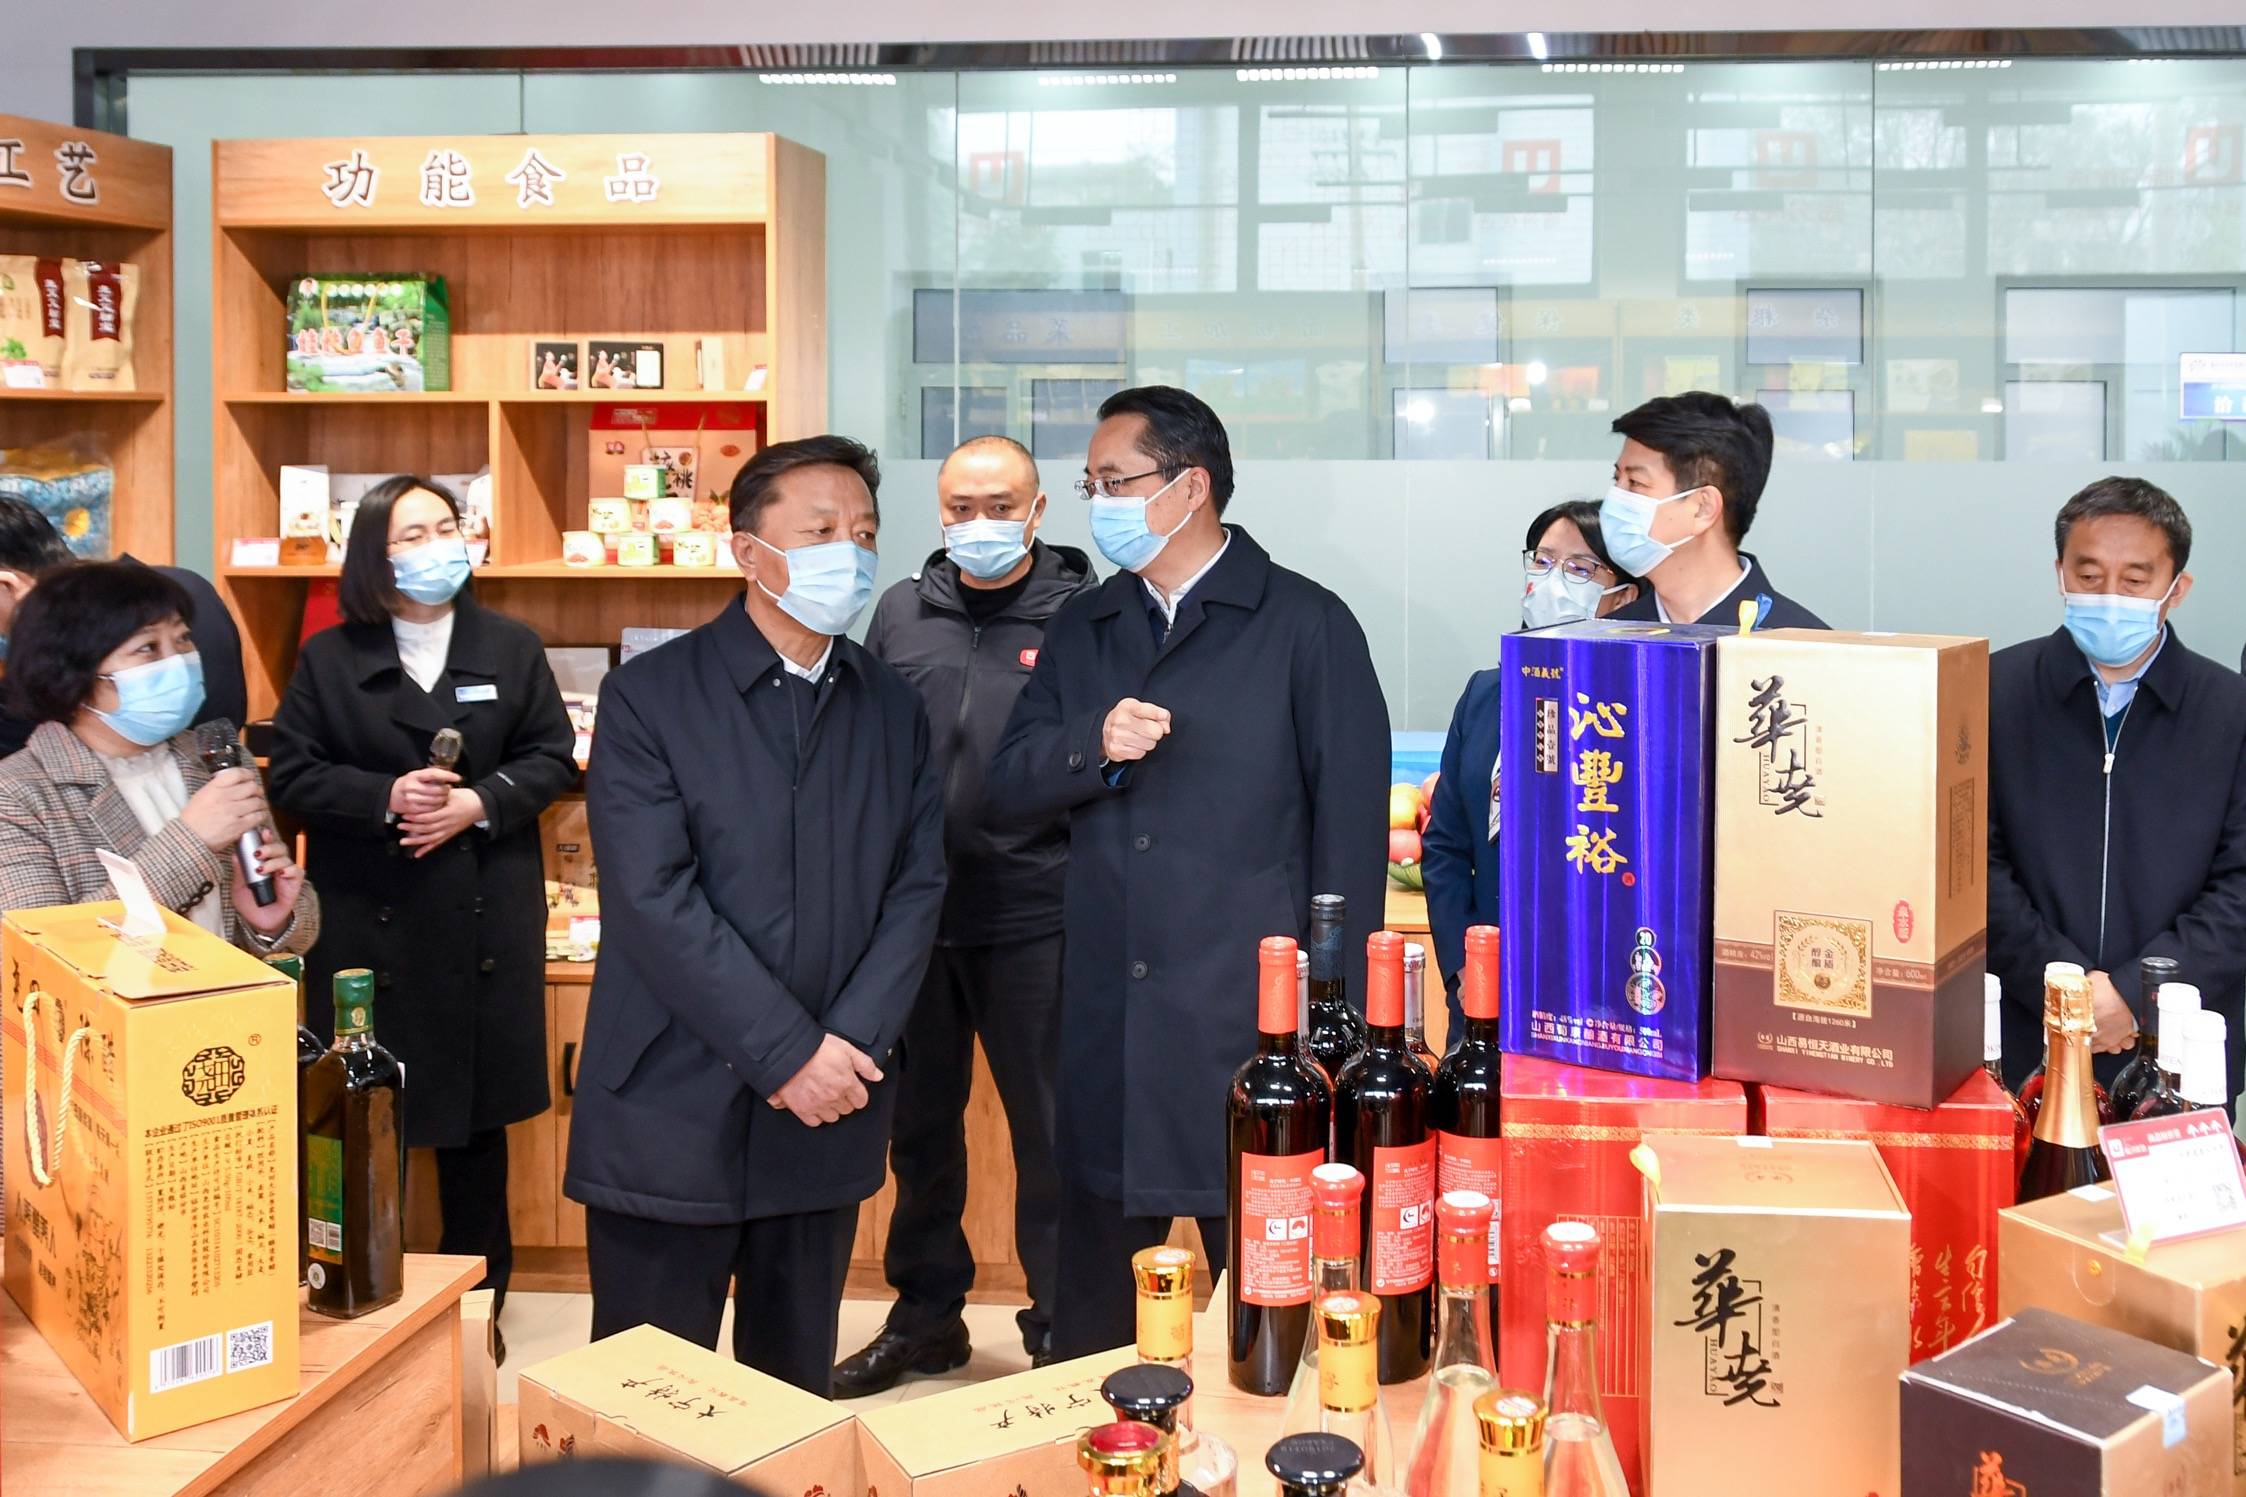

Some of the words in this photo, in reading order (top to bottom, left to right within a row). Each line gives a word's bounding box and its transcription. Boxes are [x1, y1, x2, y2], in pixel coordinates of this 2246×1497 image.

[322, 147, 660, 208] 功能食品
[1565, 690, 1629, 876] 沁豐裕
[1776, 1035, 1894, 1062] 山西易恒天酒业有限公司
[1710, 1338, 1718, 1393] HUAYAO
[990, 1387, 1102, 1429] 宁特产
